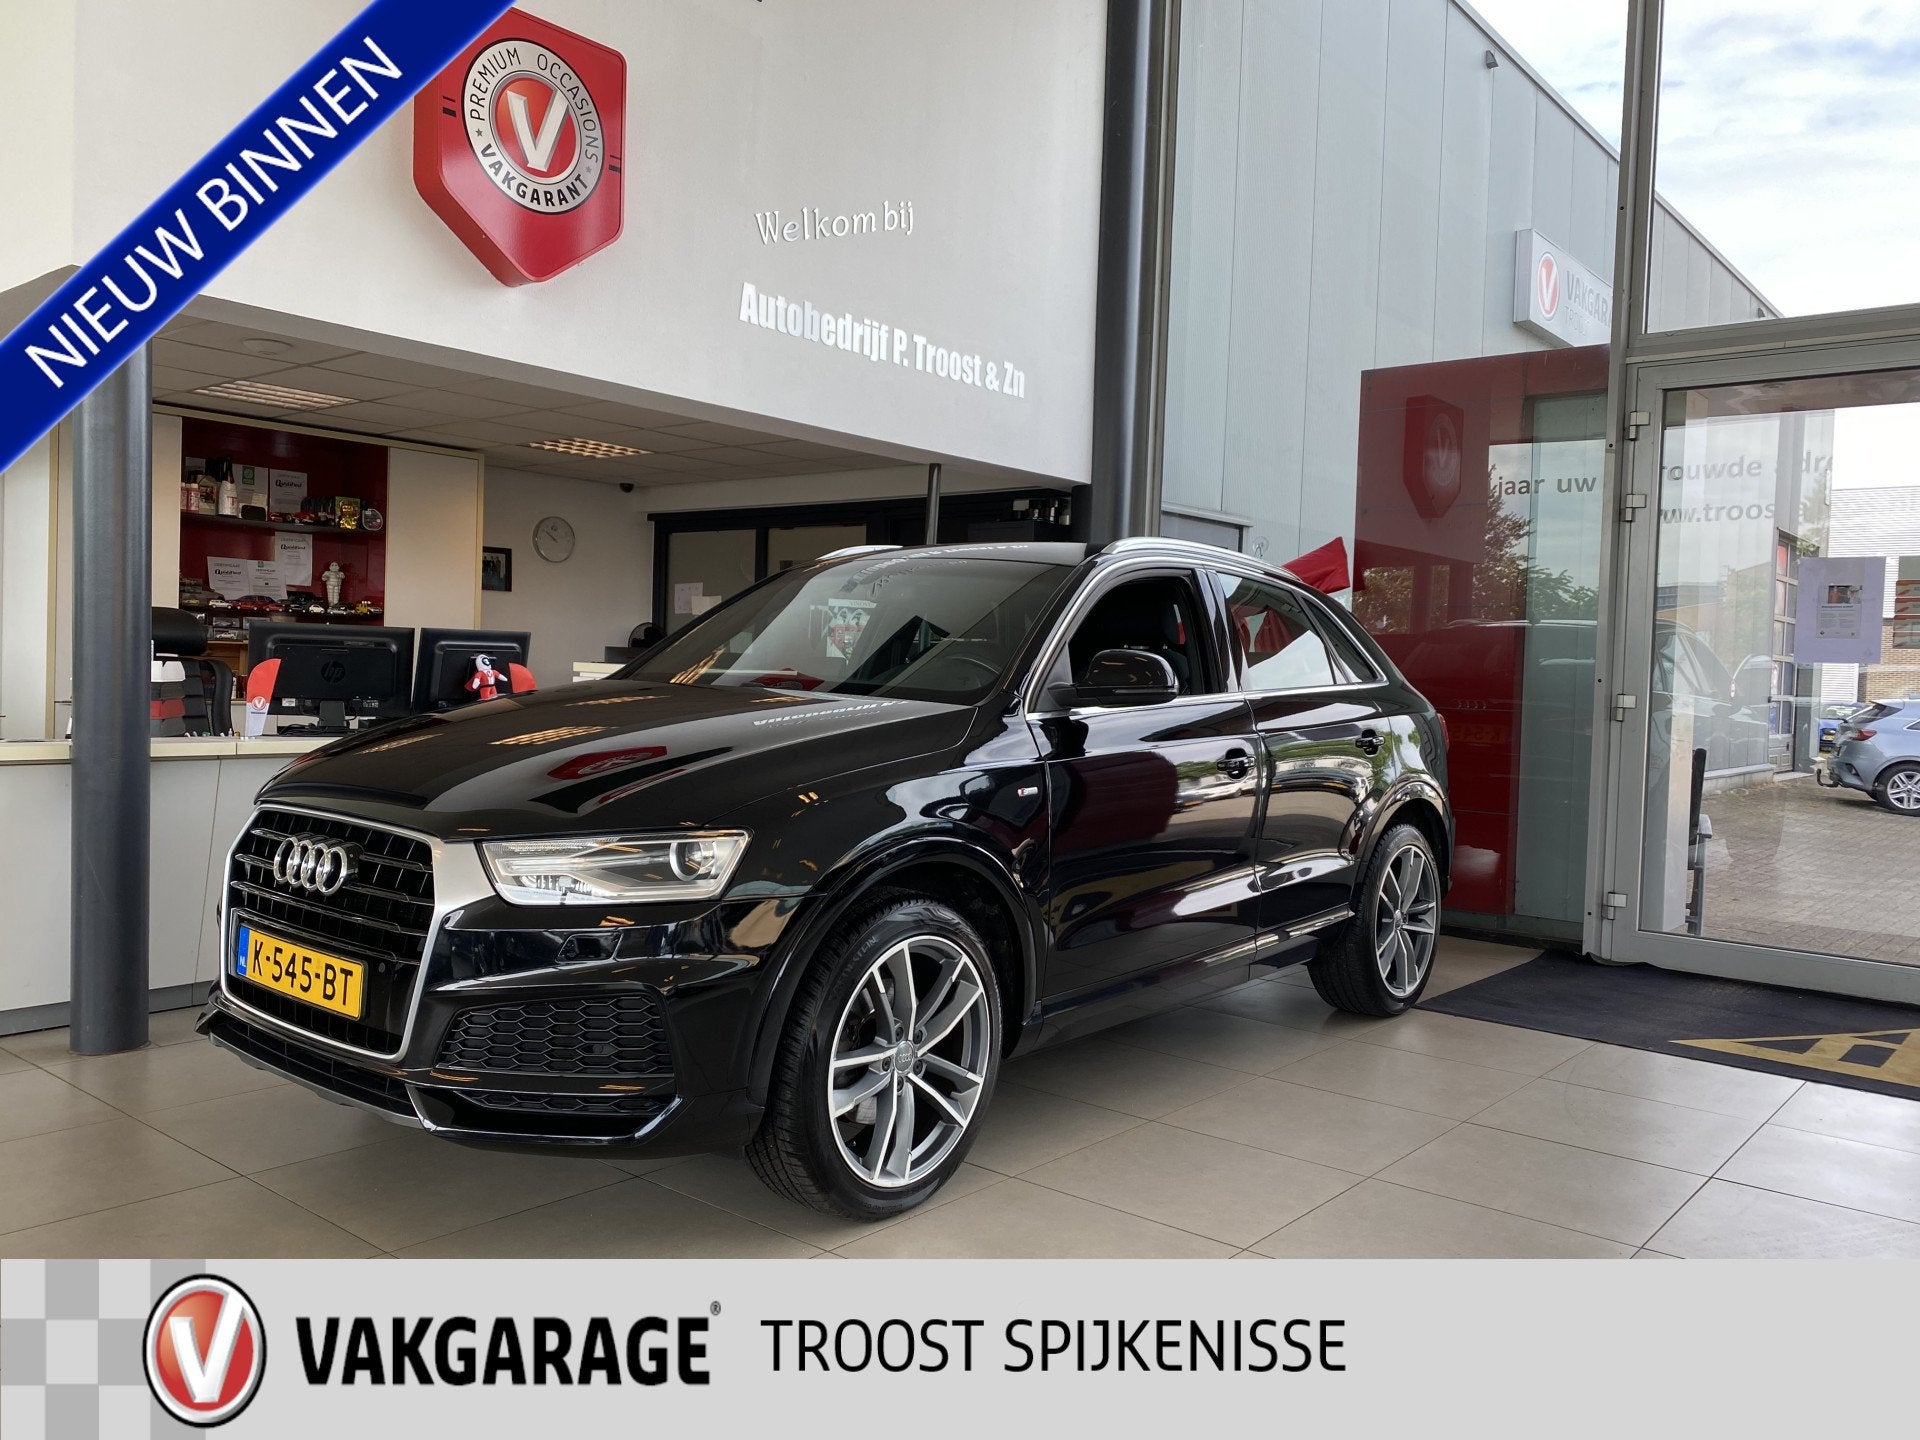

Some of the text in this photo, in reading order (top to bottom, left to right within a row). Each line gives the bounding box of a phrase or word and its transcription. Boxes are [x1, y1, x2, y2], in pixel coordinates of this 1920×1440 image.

[470, 47, 599, 164] PREMIUM OCCASIONS
[480, 143, 588, 207] VAKGARANT
[755, 200, 914, 245] Welkom bij
[1566, 270, 1612, 328] VAKGAR
[739, 281, 1026, 399] Autobedrijf P. Troost & Zn
[1498, 476, 1545, 500] jaar
[1556, 476, 1597, 493] uw
[239, 956, 247, 968] NL
[252, 939, 353, 1006] K-545-BT
